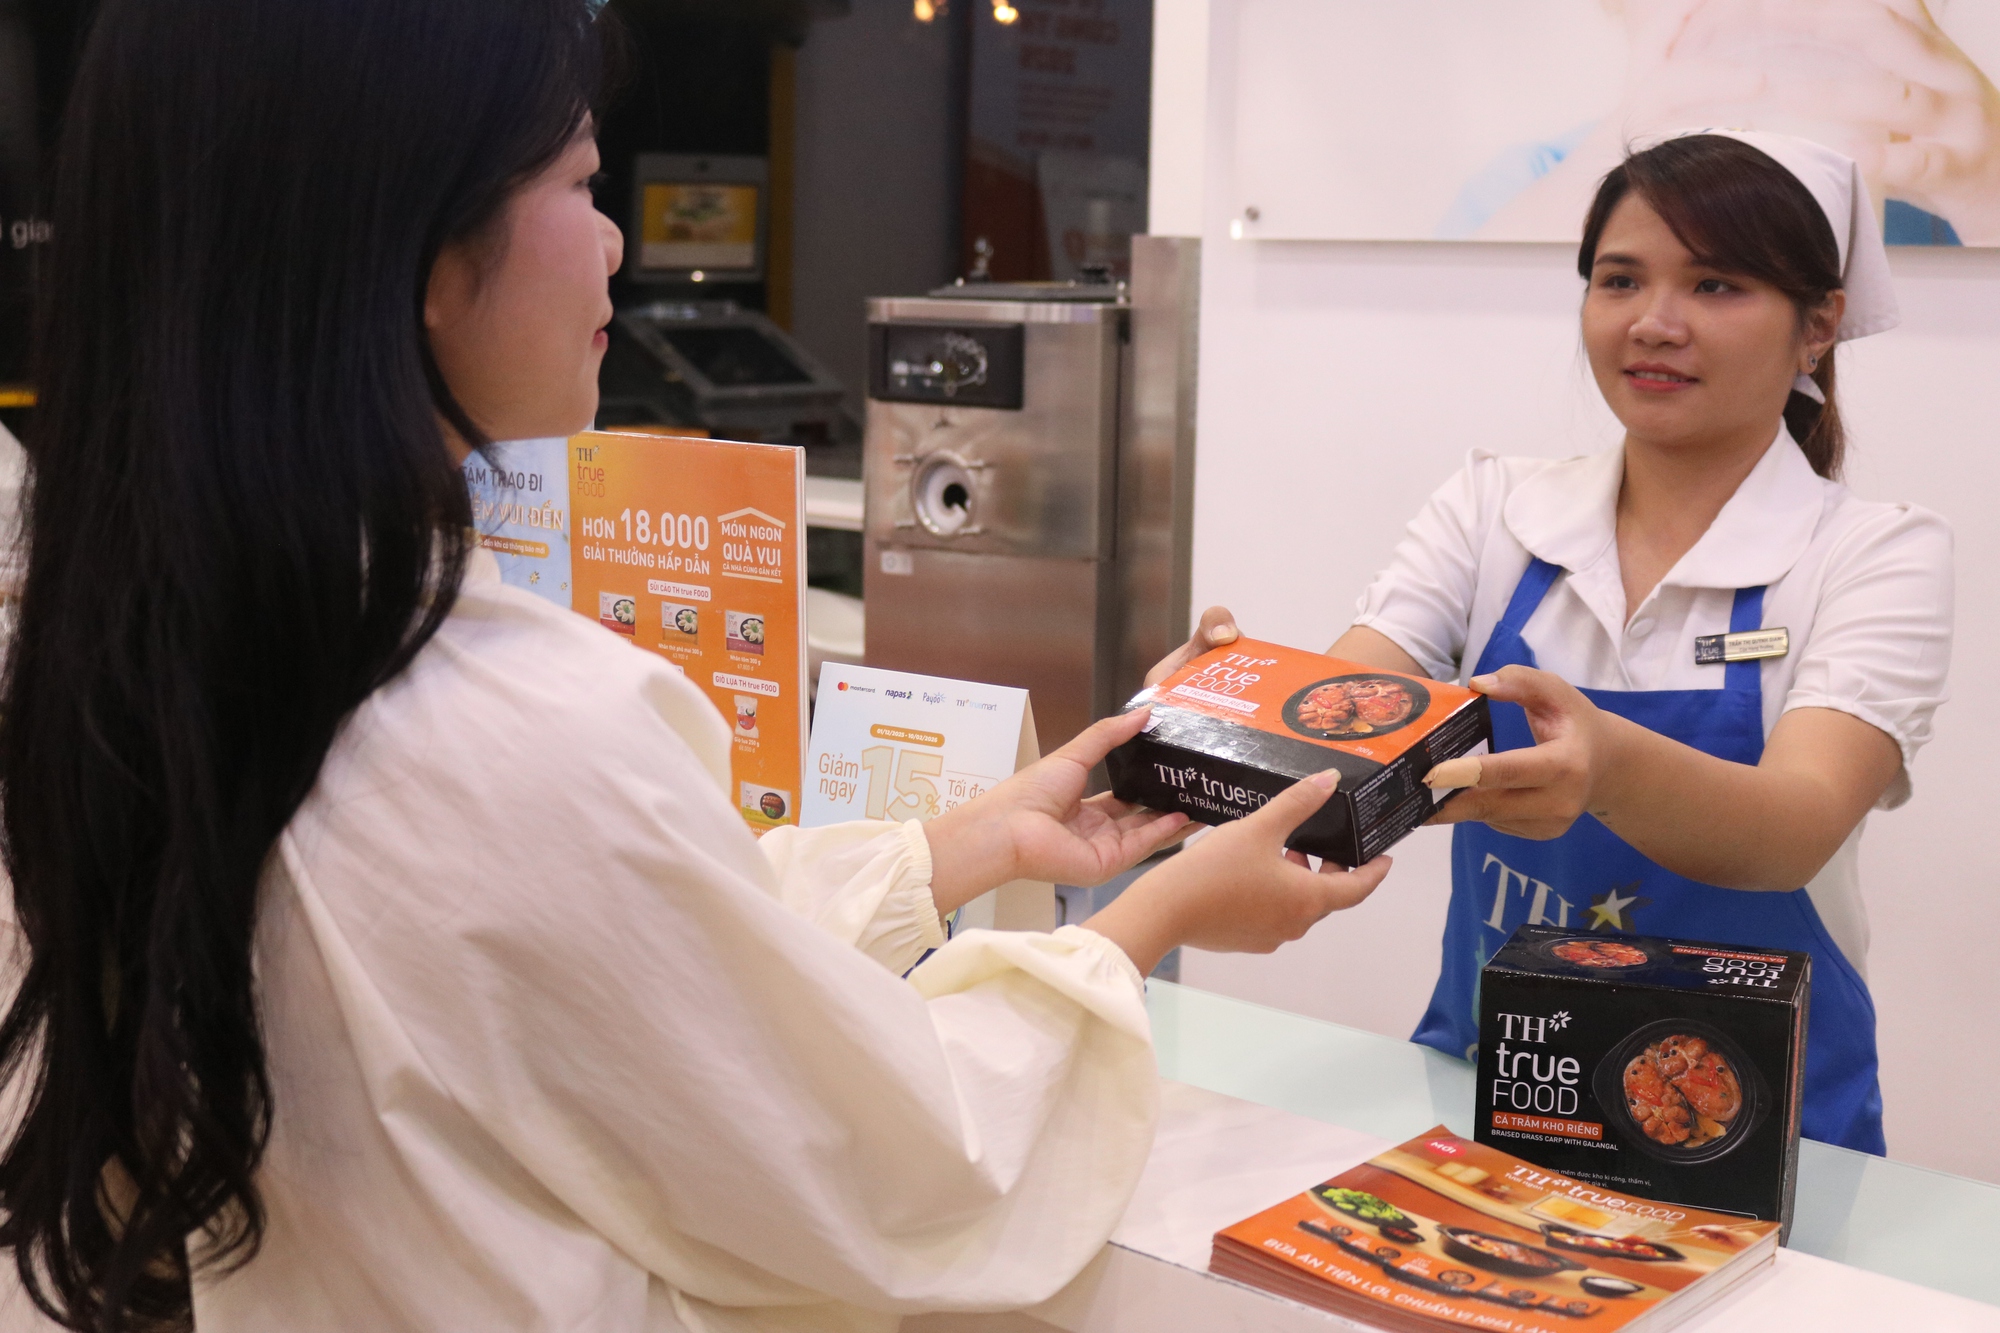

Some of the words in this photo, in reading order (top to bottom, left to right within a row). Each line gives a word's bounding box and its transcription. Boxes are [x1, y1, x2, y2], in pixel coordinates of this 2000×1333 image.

[576, 447, 593, 461] TH
[490, 467, 525, 490] TRAO
[528, 473, 543, 492] ĐI
[577, 462, 605, 482] true
[577, 481, 605, 498] FOOD
[499, 502, 525, 525] VUI
[528, 499, 564, 530] ĐẾN
[582, 516, 615, 540] HƠN
[620, 507, 709, 551] 18,000
[721, 520, 746, 538] MÓN
[750, 524, 782, 542] NGON
[583, 541, 605, 562] GIẢI
[608, 545, 655, 568] THƯỞNG
[658, 550, 682, 571] HẤP
[685, 553, 710, 576] DẪN
[723, 540, 754, 563] QUÀ
[757, 545, 781, 567] VUI
[672, 586, 680, 594] TH
[681, 588, 692, 596] true
[694, 589, 709, 598] FOOD
[1224, 652, 1258, 668] TH
[715, 674, 726, 684] GIÒ
[738, 680, 746, 688] TH
[747, 682, 760, 690] true
[760, 684, 777, 693] FOOD
[1183, 672, 1246, 696] FOOD
[1203, 661, 1261, 686] true
[850, 685, 876, 694] mastercard
[922, 692, 942, 705] Payoo
[818, 752, 860, 779] Giảm
[819, 777, 858, 805] ngay
[948, 778, 967, 798] Tối
[1154, 763, 1187, 789] TH
[1200, 772, 1276, 809] trueFO
[1178, 792, 1192, 804] CÁ
[1222, 806, 1244, 819] KHO
[1482, 852, 1575, 935] TH
[1702, 964, 1781, 980] true
[1706, 957, 1786, 972] FOOD
[1731, 976, 1778, 989] TH
[1497, 1012, 1549, 1044] TH
[1496, 1042, 1581, 1085] true
[1492, 1079, 1578, 1115] FOOD
[1494, 1114, 1508, 1125] CÁ
[1511, 1116, 1540, 1129] TRẮM
[1542, 1120, 1564, 1132] KHO
[1491, 1129, 1521, 1139] BRAISED
[1522, 1132, 1544, 1142] GRASS
[1544, 1135, 1563, 1144] CARP
[1564, 1138, 1582, 1147] WITH
[1582, 1140, 1619, 1151] GALANGAL
[1514, 1164, 1552, 1186] TH
[1568, 1185, 1686, 1221] trueFOOD
